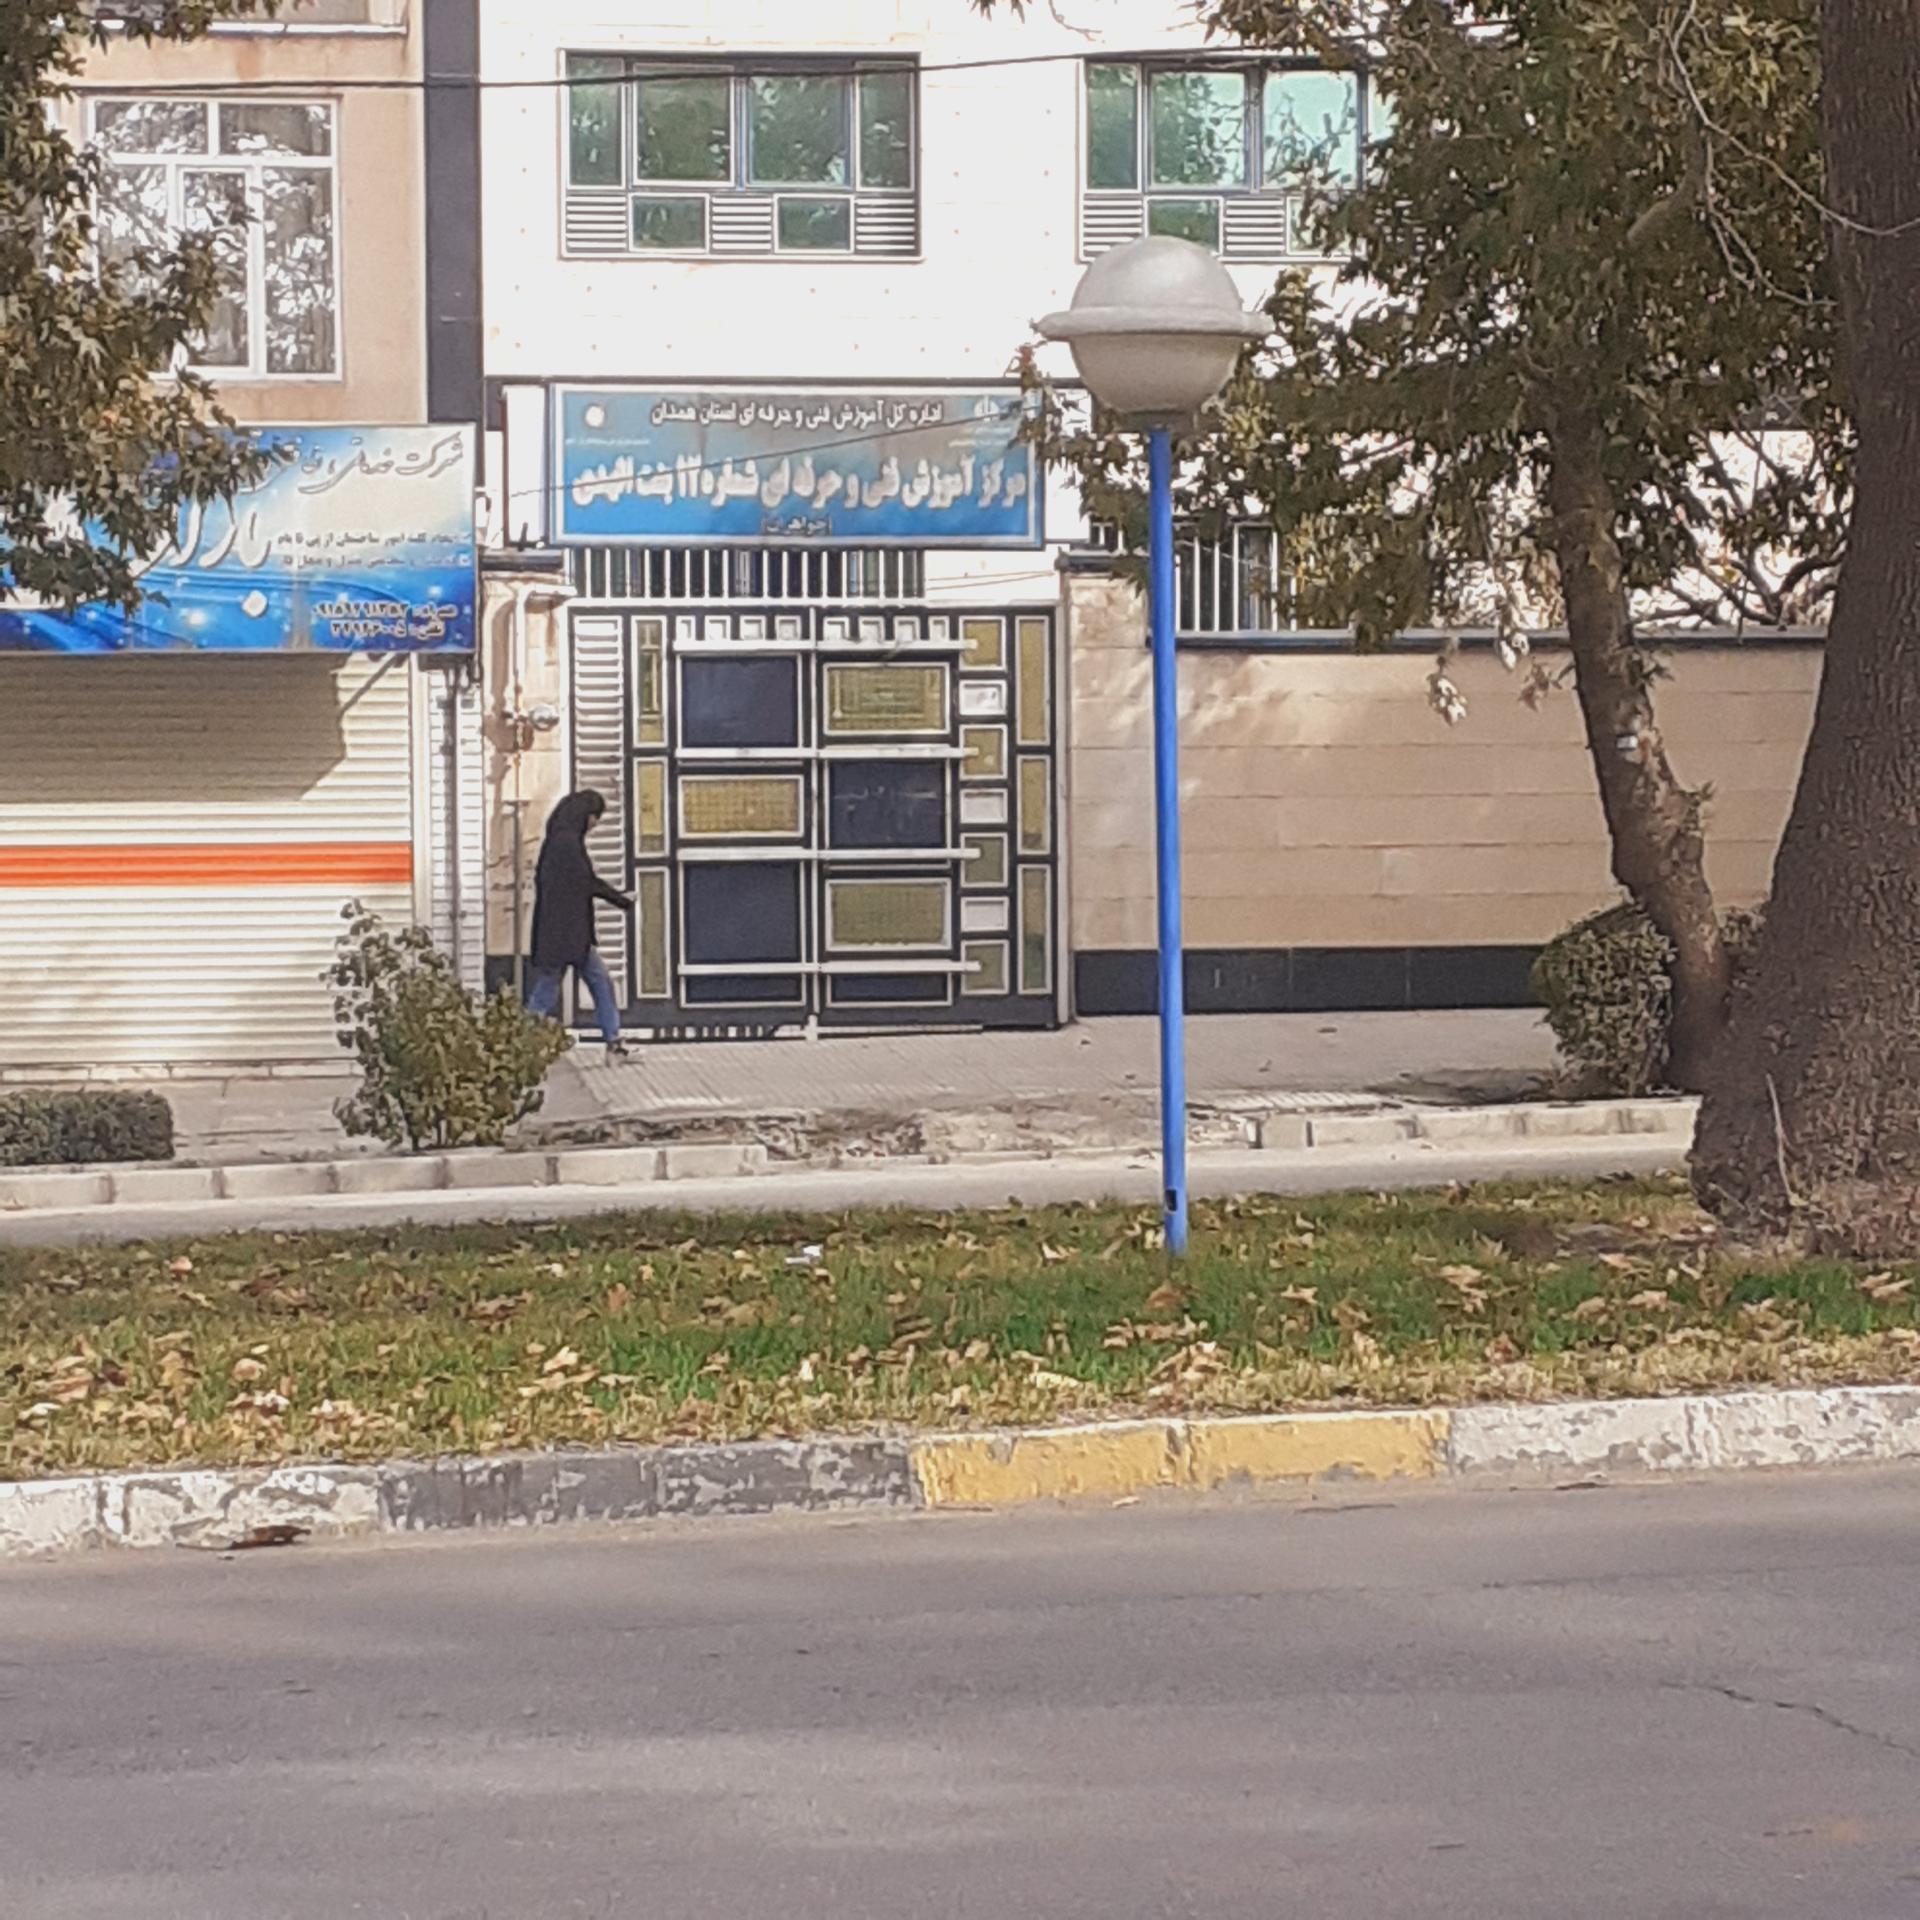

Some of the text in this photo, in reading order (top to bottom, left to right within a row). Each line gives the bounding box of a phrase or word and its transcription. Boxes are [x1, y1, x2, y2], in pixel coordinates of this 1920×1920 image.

[650, 399, 943, 431] اداره کل آموزش فنی و حرفه ای استان همدان
[298, 436, 394, 495] خدماتی
[395, 430, 464, 478] شرکت
[701, 456, 760, 508] شماره
[761, 456, 791, 509] ای
[793, 455, 843, 509] حرفه
[844, 474, 859, 509] و
[861, 456, 900, 509] فنی
[901, 453, 976, 509] آموزش
[978, 458, 1027, 509] مرکز
